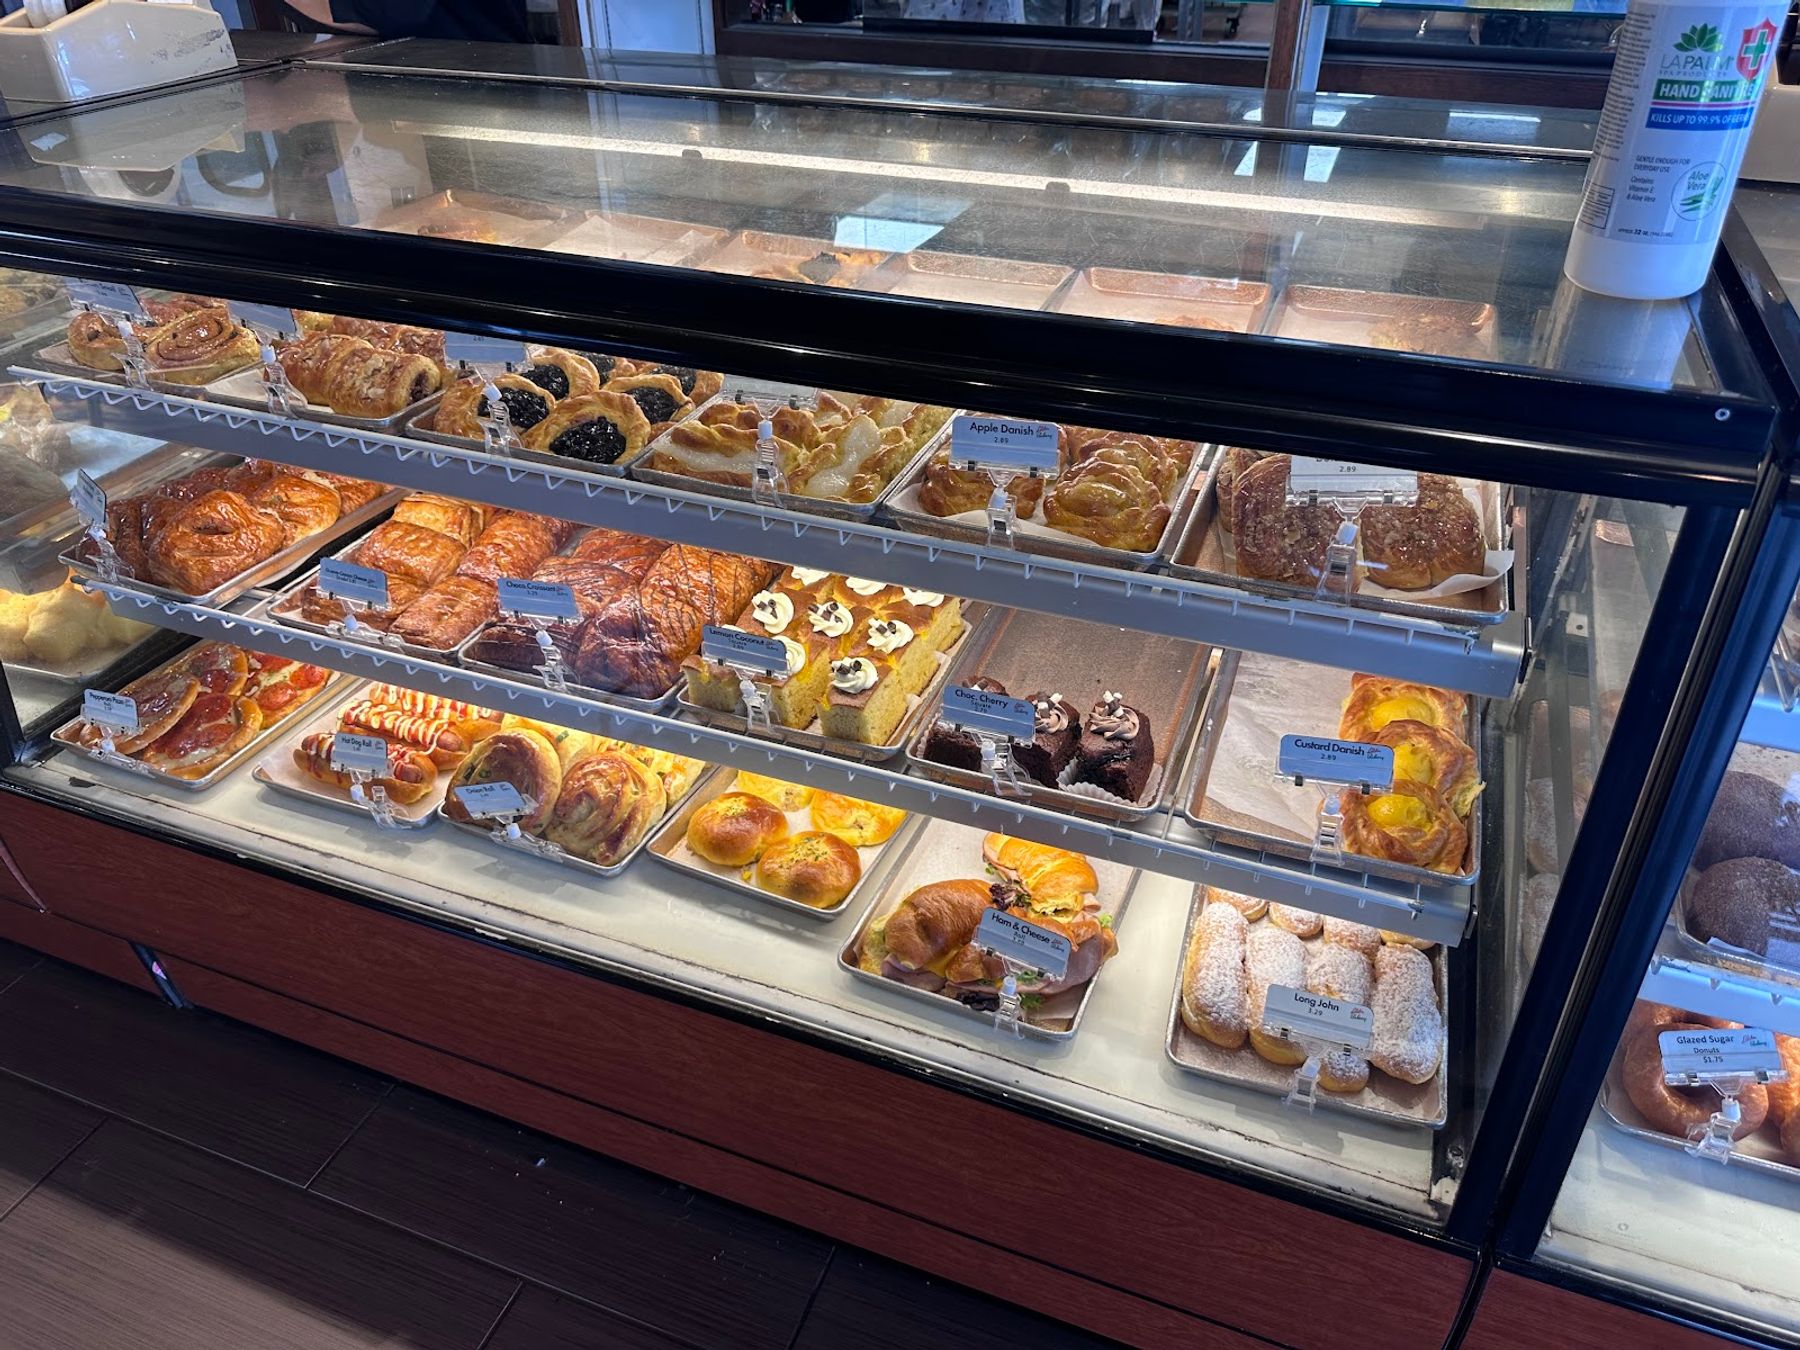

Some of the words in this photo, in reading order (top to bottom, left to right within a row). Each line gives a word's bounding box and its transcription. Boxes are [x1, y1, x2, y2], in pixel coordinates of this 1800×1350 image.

[1660, 83, 1700, 98] HAND
[1650, 113, 1672, 124] KILLS
[1673, 114, 1685, 124] UP
[1685, 115, 1697, 125] TO
[1697, 115, 1721, 125] 99.9%
[1659, 165, 1670, 173] USE
[1688, 170, 1709, 180] Aloe
[1630, 176, 1655, 184] Contains
[1687, 181, 1706, 191] Vera
[970, 421, 999, 434] Apple
[1001, 424, 1034, 435] Danish
[1339, 465, 1357, 473] 2.89
[709, 627, 734, 639] Lemon
[734, 633, 764, 646] Coconut
[955, 689, 978, 701] Choc.
[979, 694, 1008, 709] Cherry
[342, 735, 350, 744] Hot
[350, 737, 361, 747] Dog
[362, 739, 372, 747] Roll
[1294, 739, 1331, 752] Custard
[1331, 743, 1365, 756] Danish
[991, 912, 1012, 928] Ham
[1012, 921, 1020, 932] &
[1021, 925, 1050, 944] Cheese
[1294, 993, 1317, 1007] Long
[1317, 999, 1339, 1012] John
[1308, 1007, 1323, 1016] 3.29
[1676, 1034, 1708, 1045] Glazed
[1709, 1034, 1734, 1045] Sugar
[1693, 1046, 1720, 1054] Donuts
